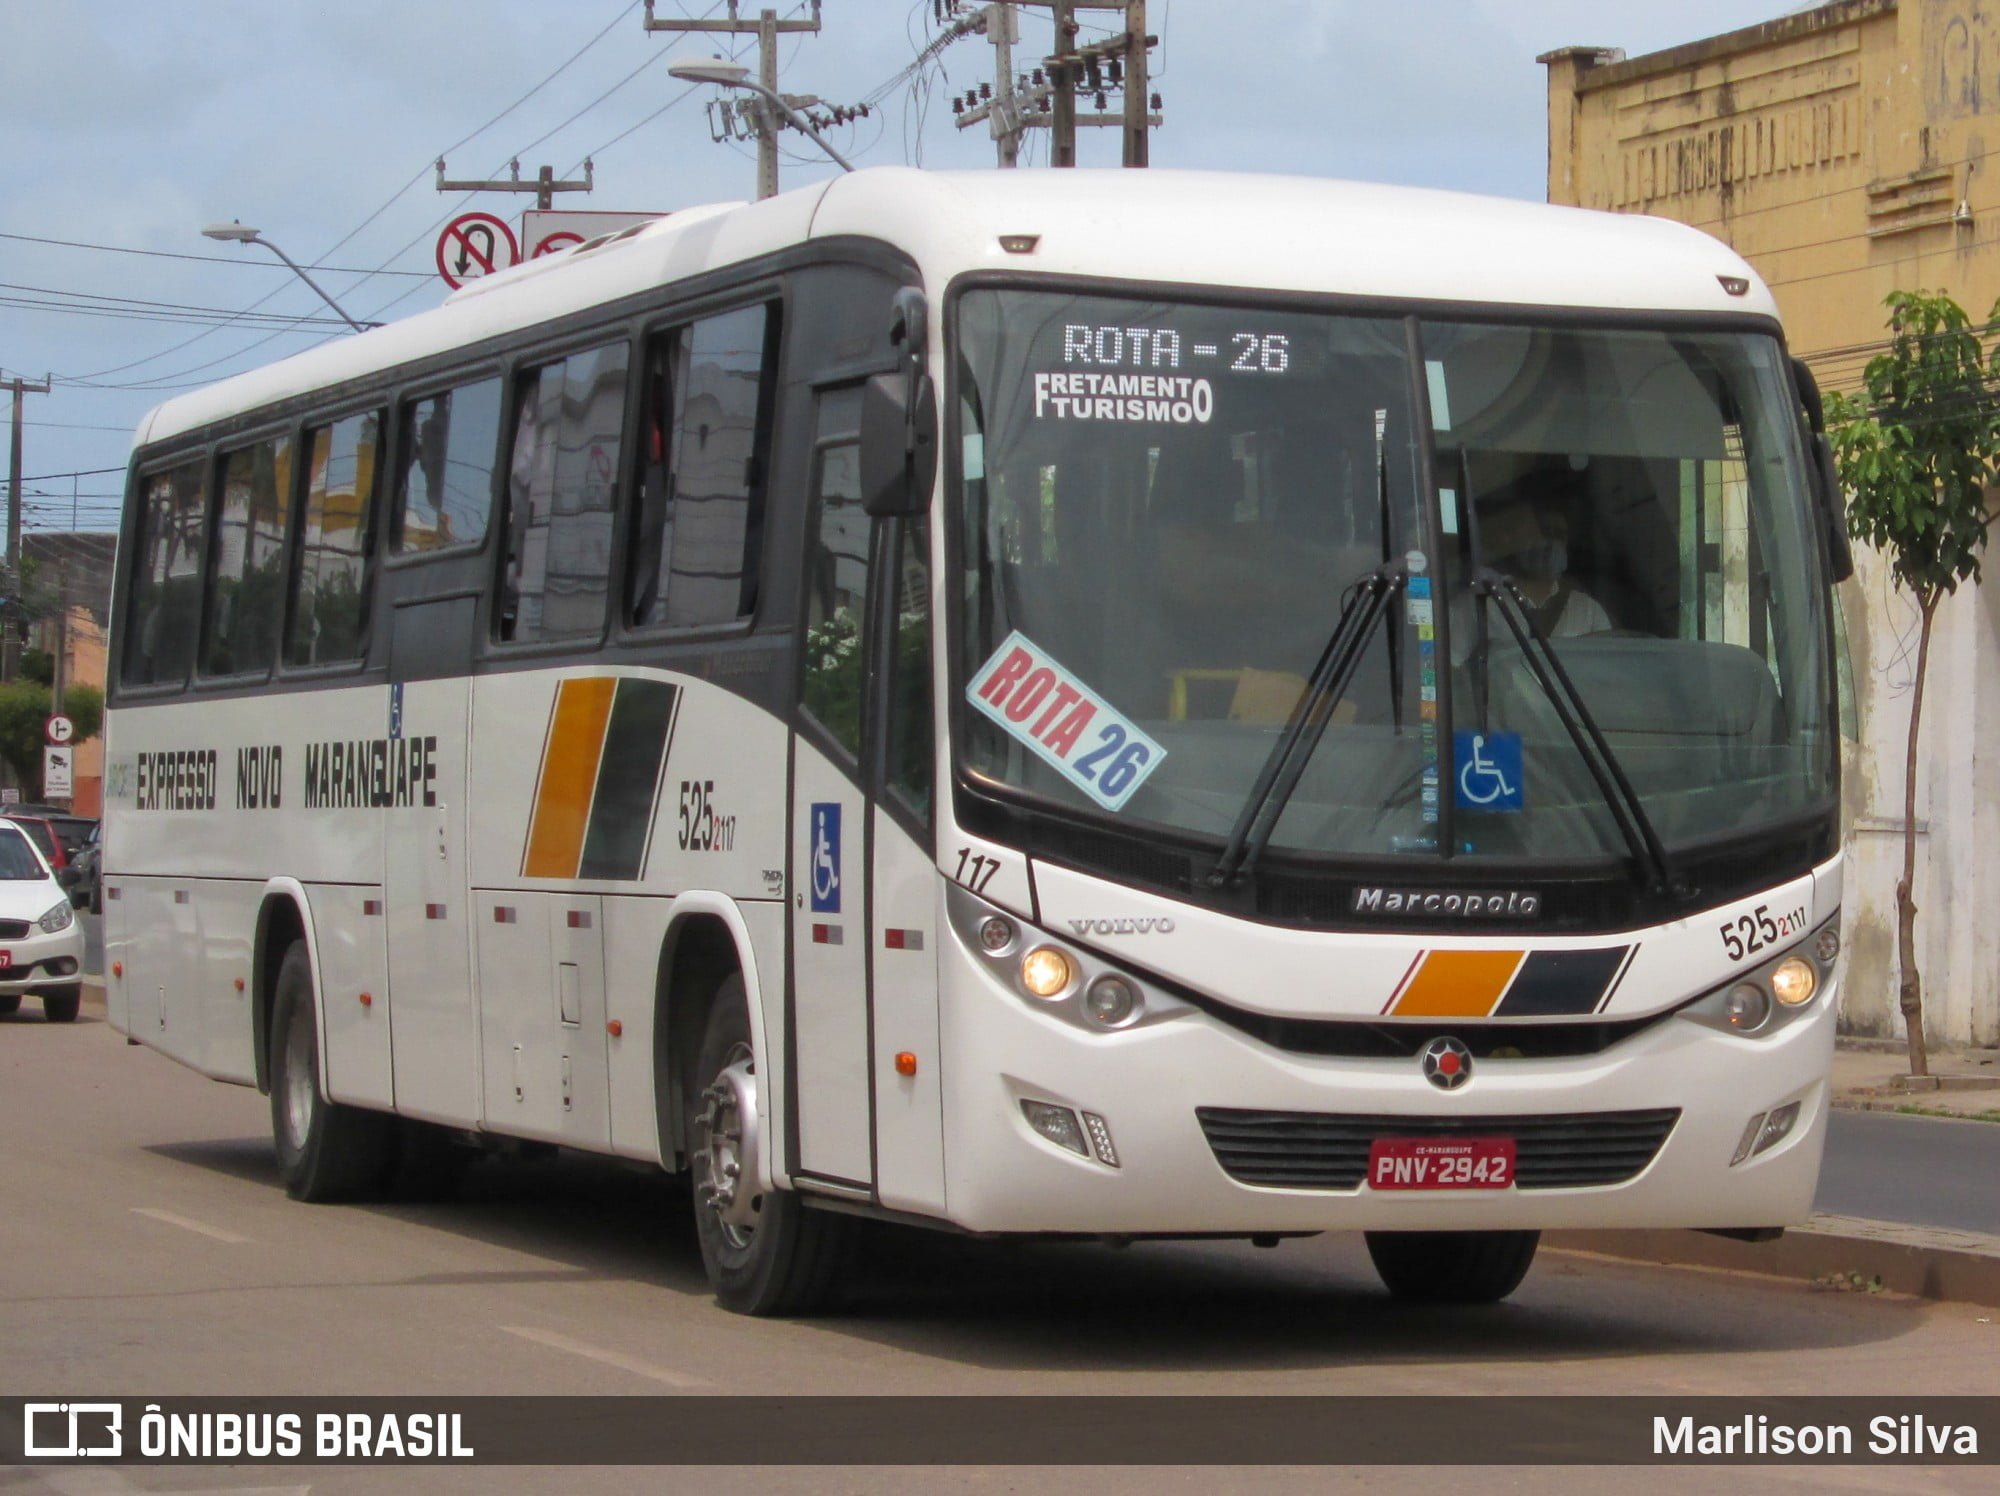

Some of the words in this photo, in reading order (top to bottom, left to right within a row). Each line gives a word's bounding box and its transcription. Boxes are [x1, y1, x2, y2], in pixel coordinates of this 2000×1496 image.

[1064, 324, 1180, 368] ROTA
[1230, 333, 1289, 373] 26
[1034, 373, 1213, 423] FRETAMENTO
[1051, 397, 1194, 423] TURISMO
[977, 647, 1097, 760] ROTA
[1072, 724, 1149, 798] 26
[137, 749, 217, 810] EXPRESSO
[237, 745, 283, 810] NOVO
[305, 736, 437, 808] MARANGUAPE
[955, 848, 1001, 892] 117
[1354, 888, 1541, 917] Marcopolo
[1067, 917, 1176, 935] VOLVO
